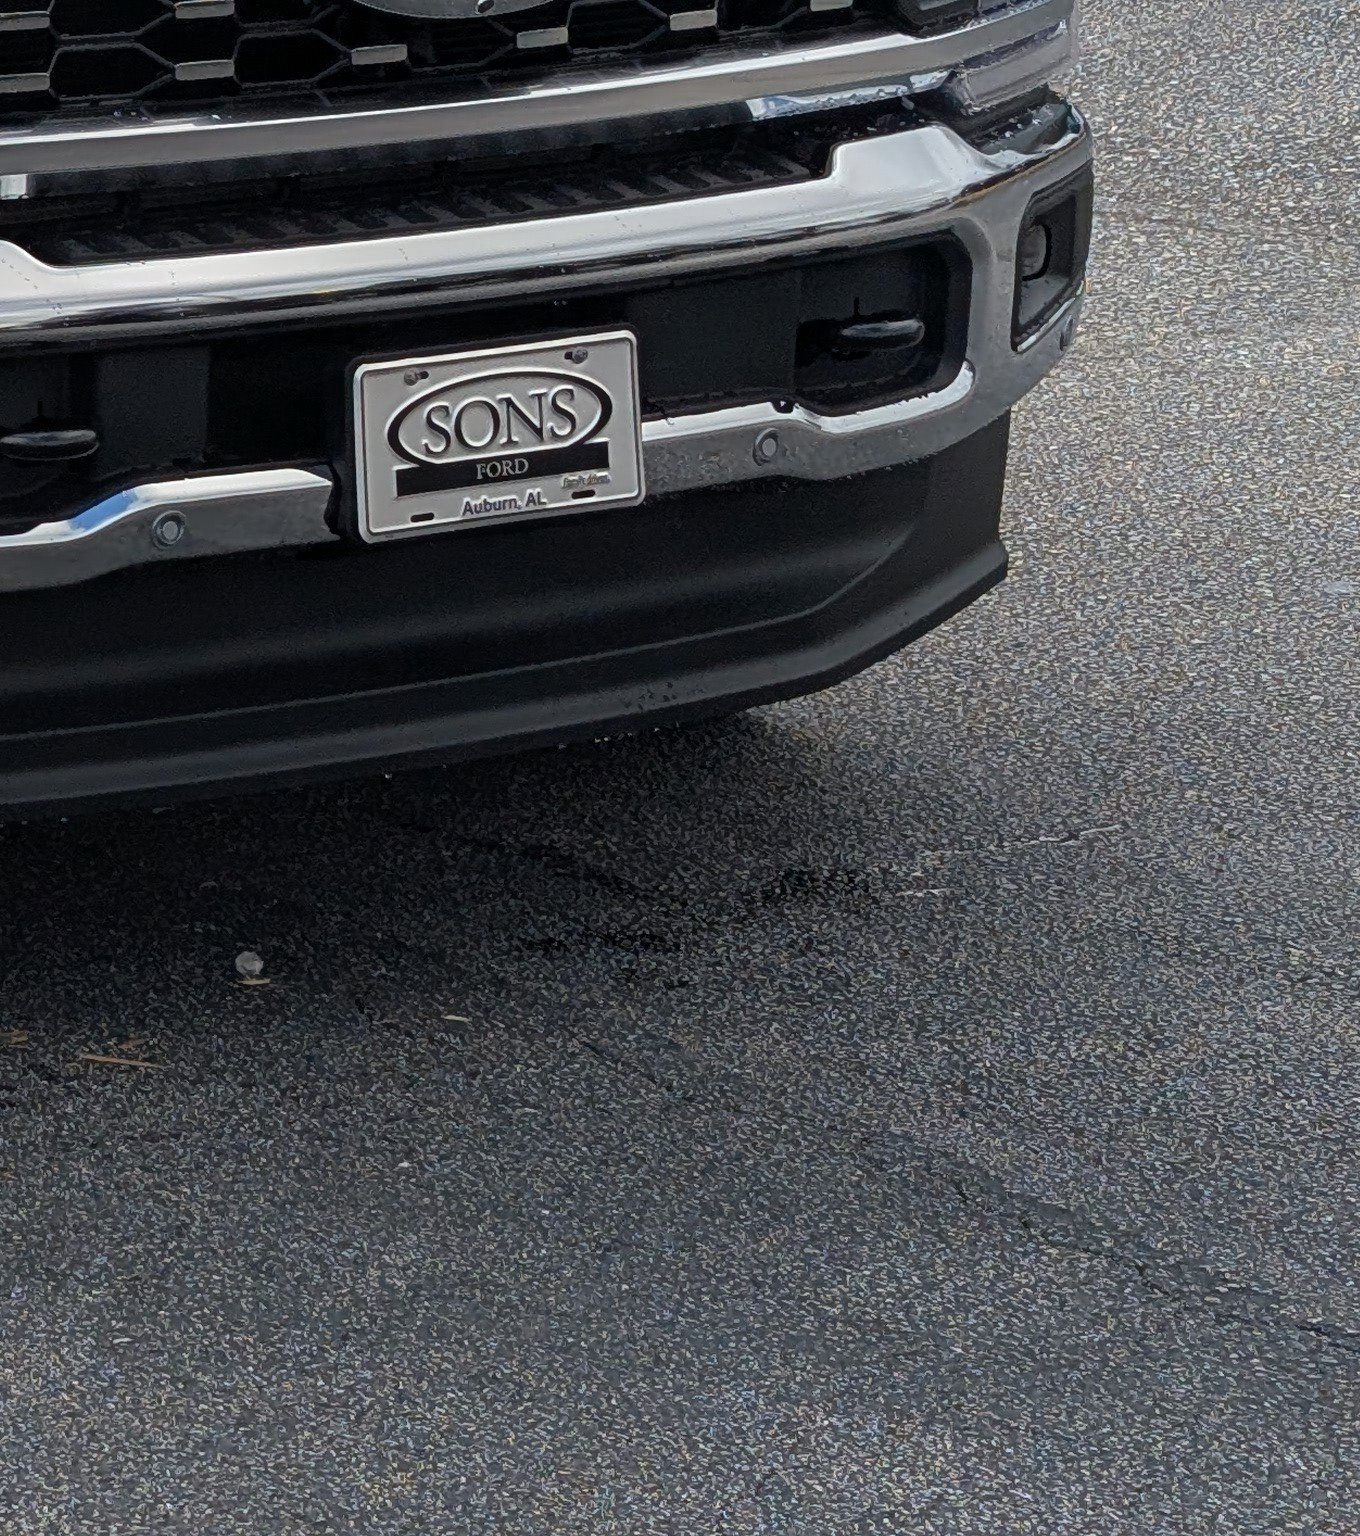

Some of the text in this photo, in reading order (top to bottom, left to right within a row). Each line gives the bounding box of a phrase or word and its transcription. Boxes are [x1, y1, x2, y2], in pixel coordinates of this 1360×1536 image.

[423, 385, 577, 455] SONS
[476, 458, 529, 480] FORD
[462, 489, 548, 516] Auburn, AL
